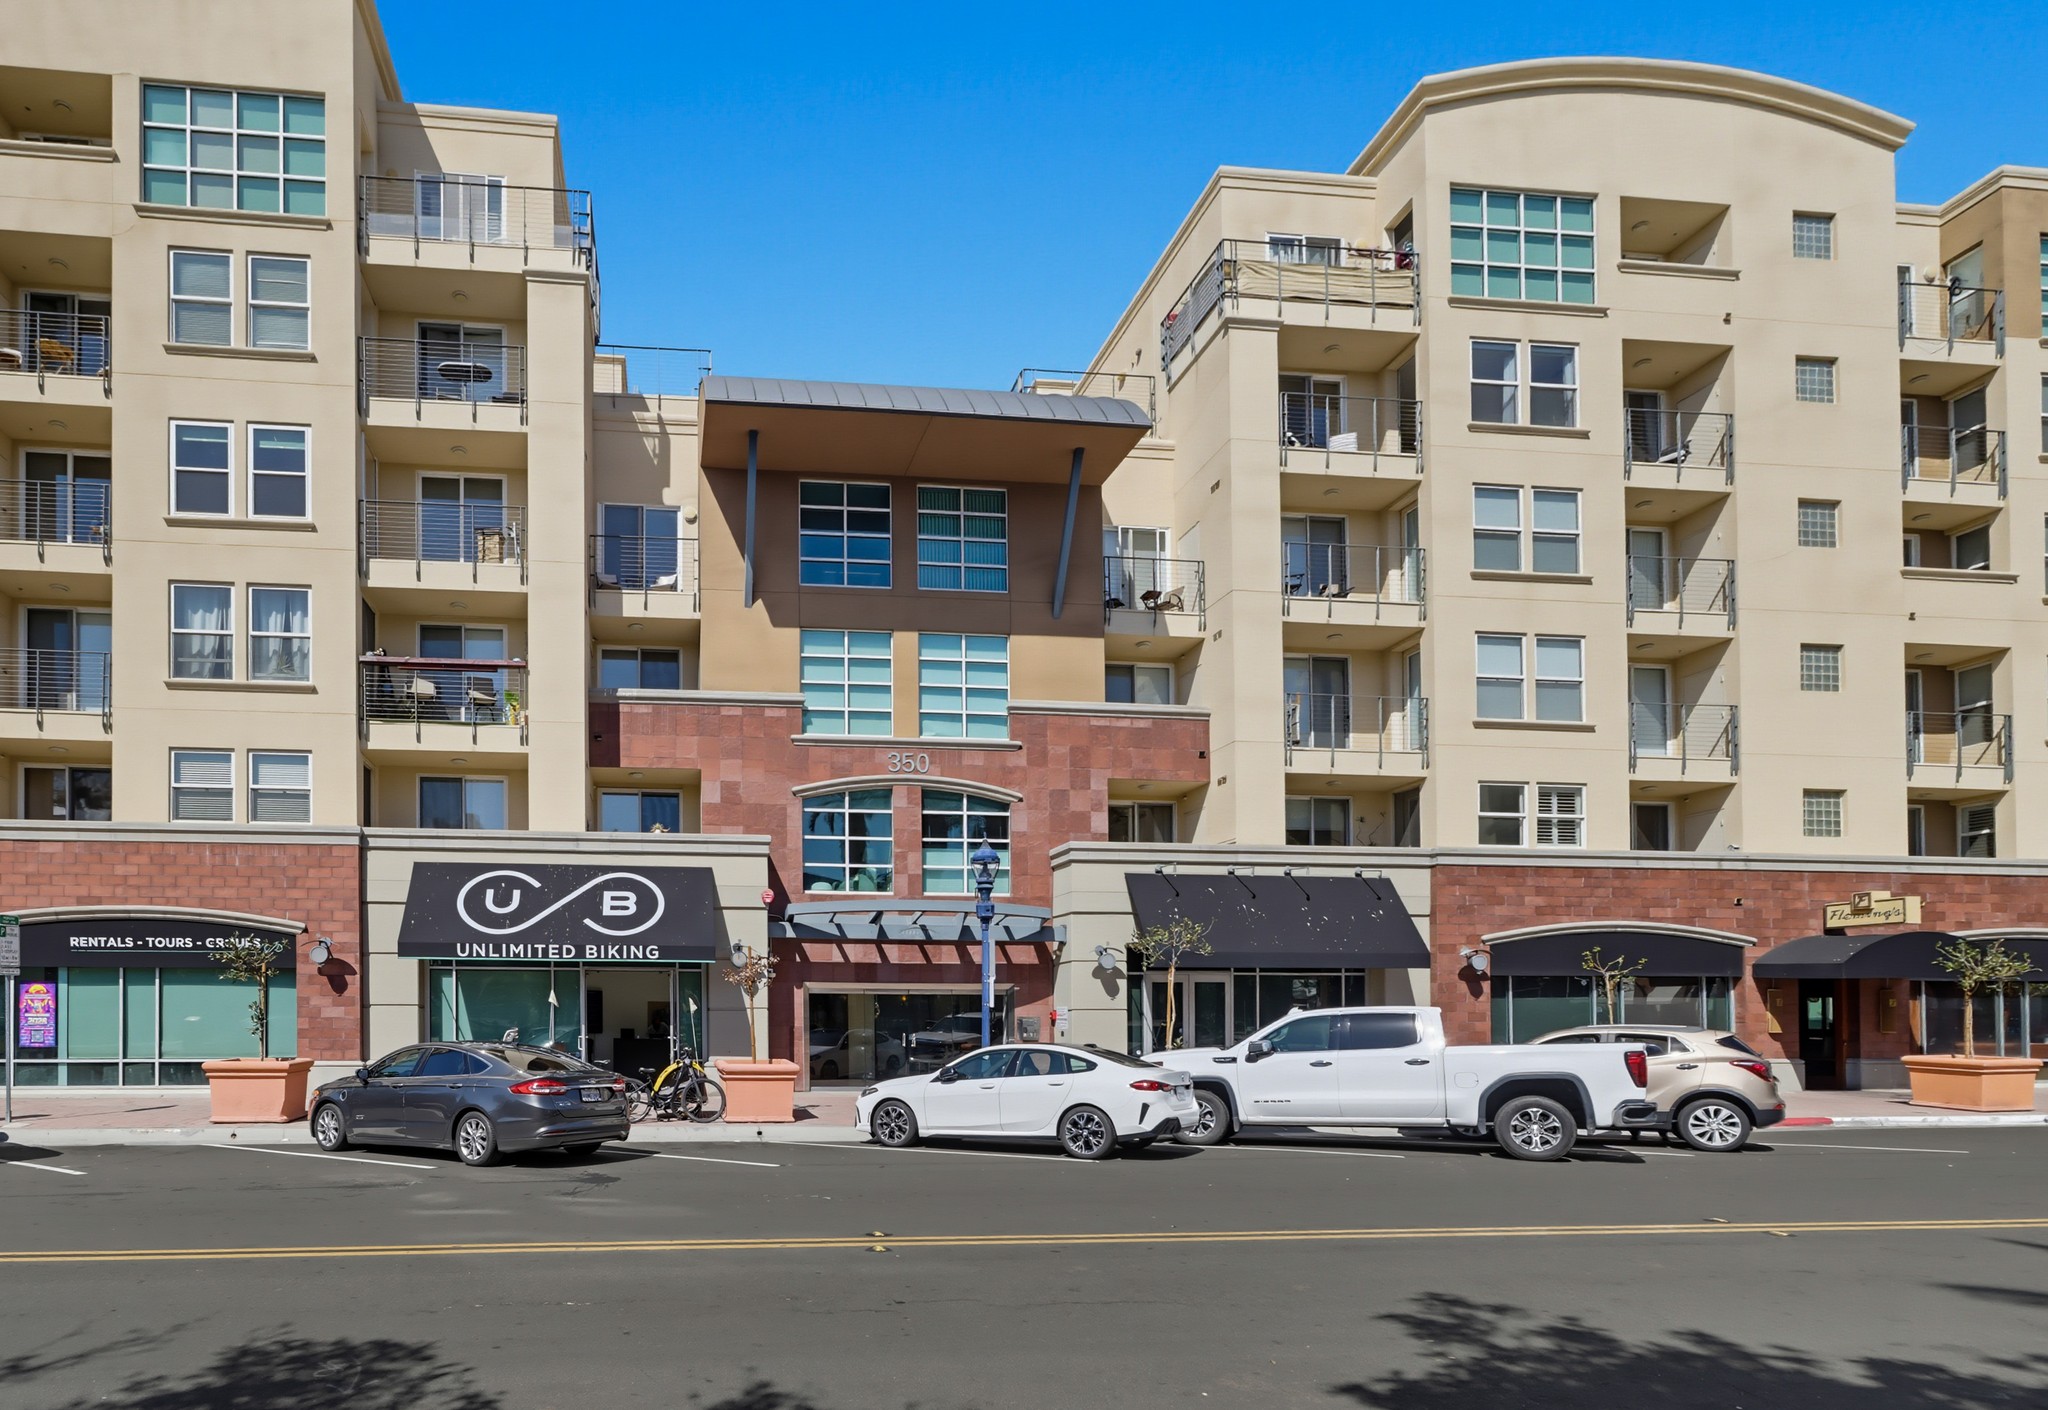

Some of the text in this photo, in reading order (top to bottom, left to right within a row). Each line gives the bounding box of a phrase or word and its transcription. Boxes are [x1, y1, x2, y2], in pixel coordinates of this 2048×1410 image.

[888, 752, 929, 773] 350
[485, 888, 637, 916] U B
[69, 936, 134, 948] RENTALS
[145, 937, 193, 948] TOURS
[456, 943, 660, 959] UNLIMITED BIKING
